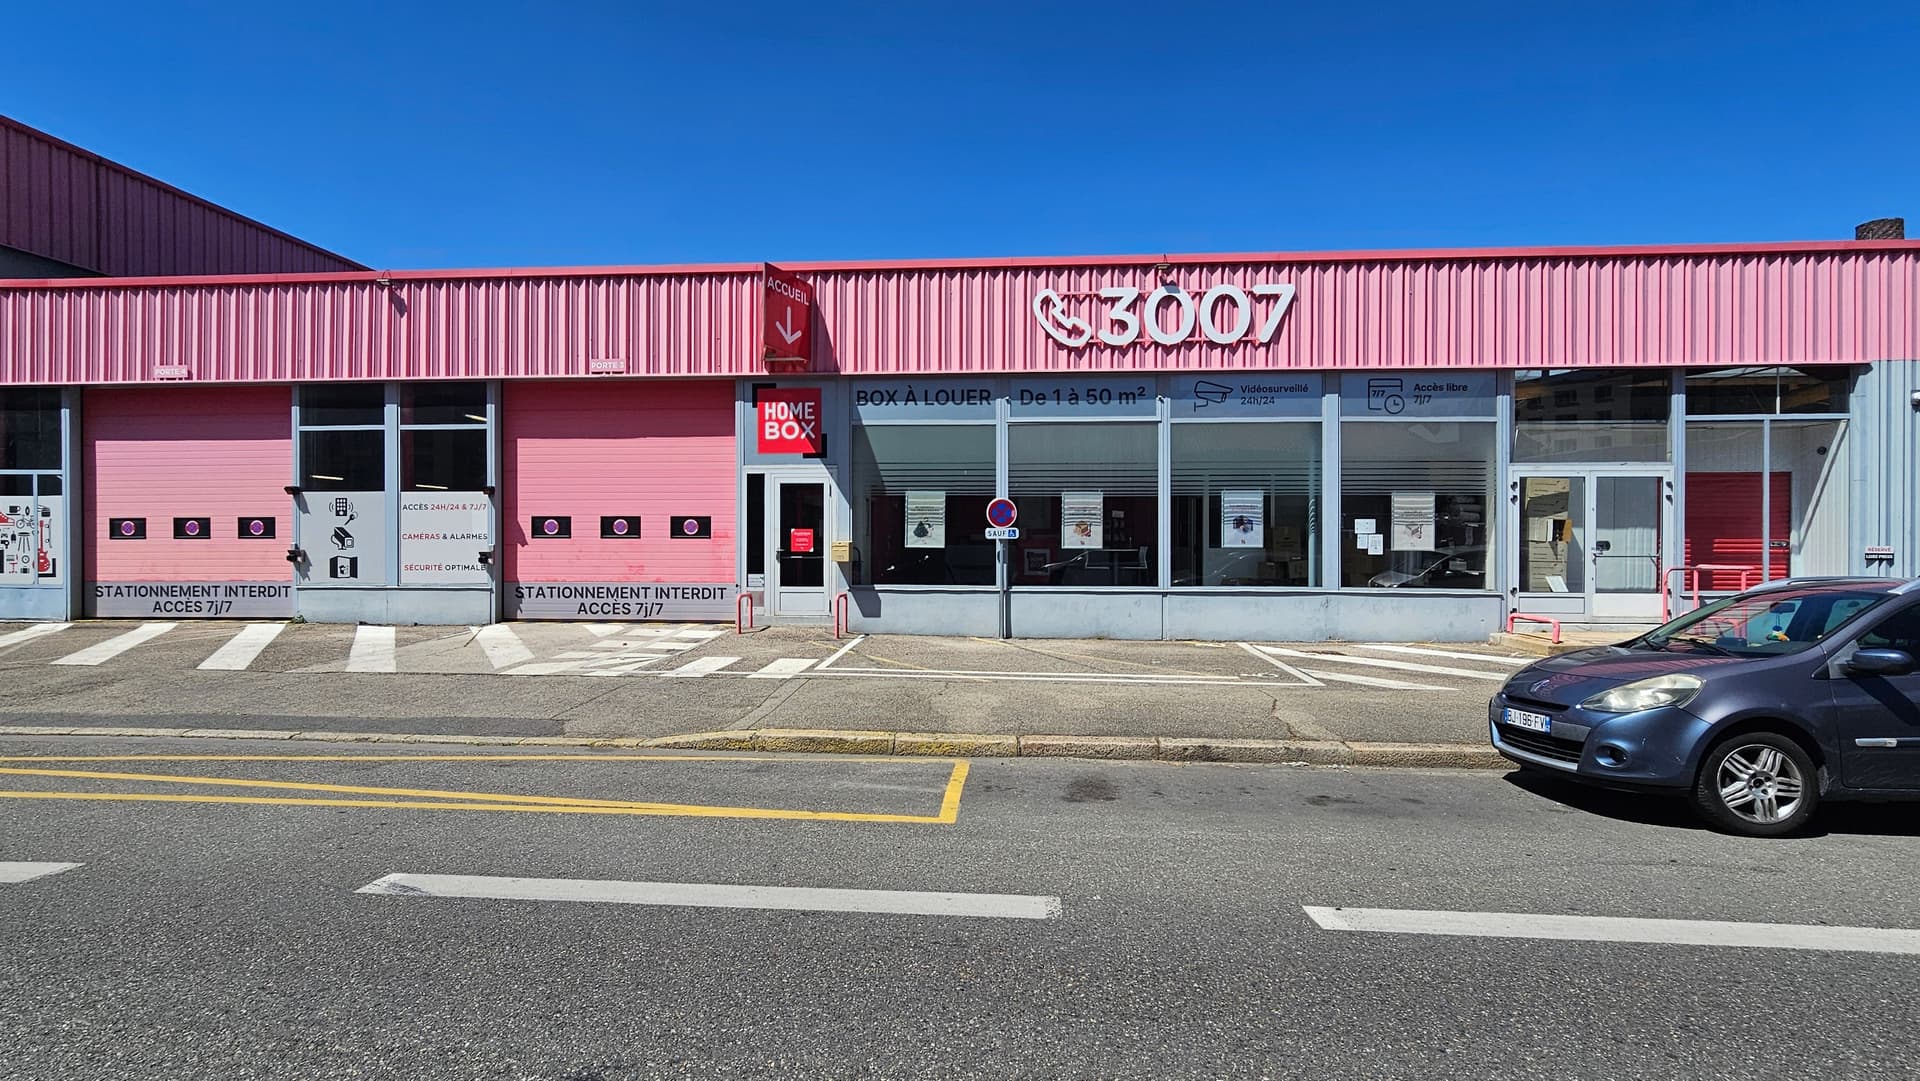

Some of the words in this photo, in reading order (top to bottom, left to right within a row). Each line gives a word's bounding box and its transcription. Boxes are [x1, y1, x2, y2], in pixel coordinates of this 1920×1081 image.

[767, 276, 809, 306] ACCUEIL
[1097, 284, 1296, 345] 3007
[591, 361, 618, 369] PORTE
[856, 389, 898, 406] BOX
[903, 384, 918, 406] À
[924, 389, 991, 406] LOUER
[1240, 384, 1309, 393] Vidéosurveillé
[1413, 383, 1444, 391] Accès
[1446, 383, 1468, 391] libre
[1020, 388, 1047, 406] De
[1052, 388, 1060, 406] 1
[1068, 387, 1079, 405] à
[1085, 388, 1112, 406] 50
[1118, 386, 1146, 405] m²
[1240, 396, 1275, 405] 24h/24
[764, 402, 815, 420] HOME
[764, 421, 816, 440] BOX
[402, 532, 440, 540] CAMÉRAS
[404, 563, 443, 571] SÉCURITÉ
[95, 585, 221, 598] STATIONNEMENT
[225, 585, 292, 598] INTERDIT
[515, 586, 651, 599] STATIONNEMENT
[655, 587, 727, 600] INTERDIT
[152, 595, 203, 612] ACCÈS
[206, 600, 233, 615] 7j/7
[577, 598, 631, 615] ACCÈS
[635, 602, 664, 617] 7j/7
